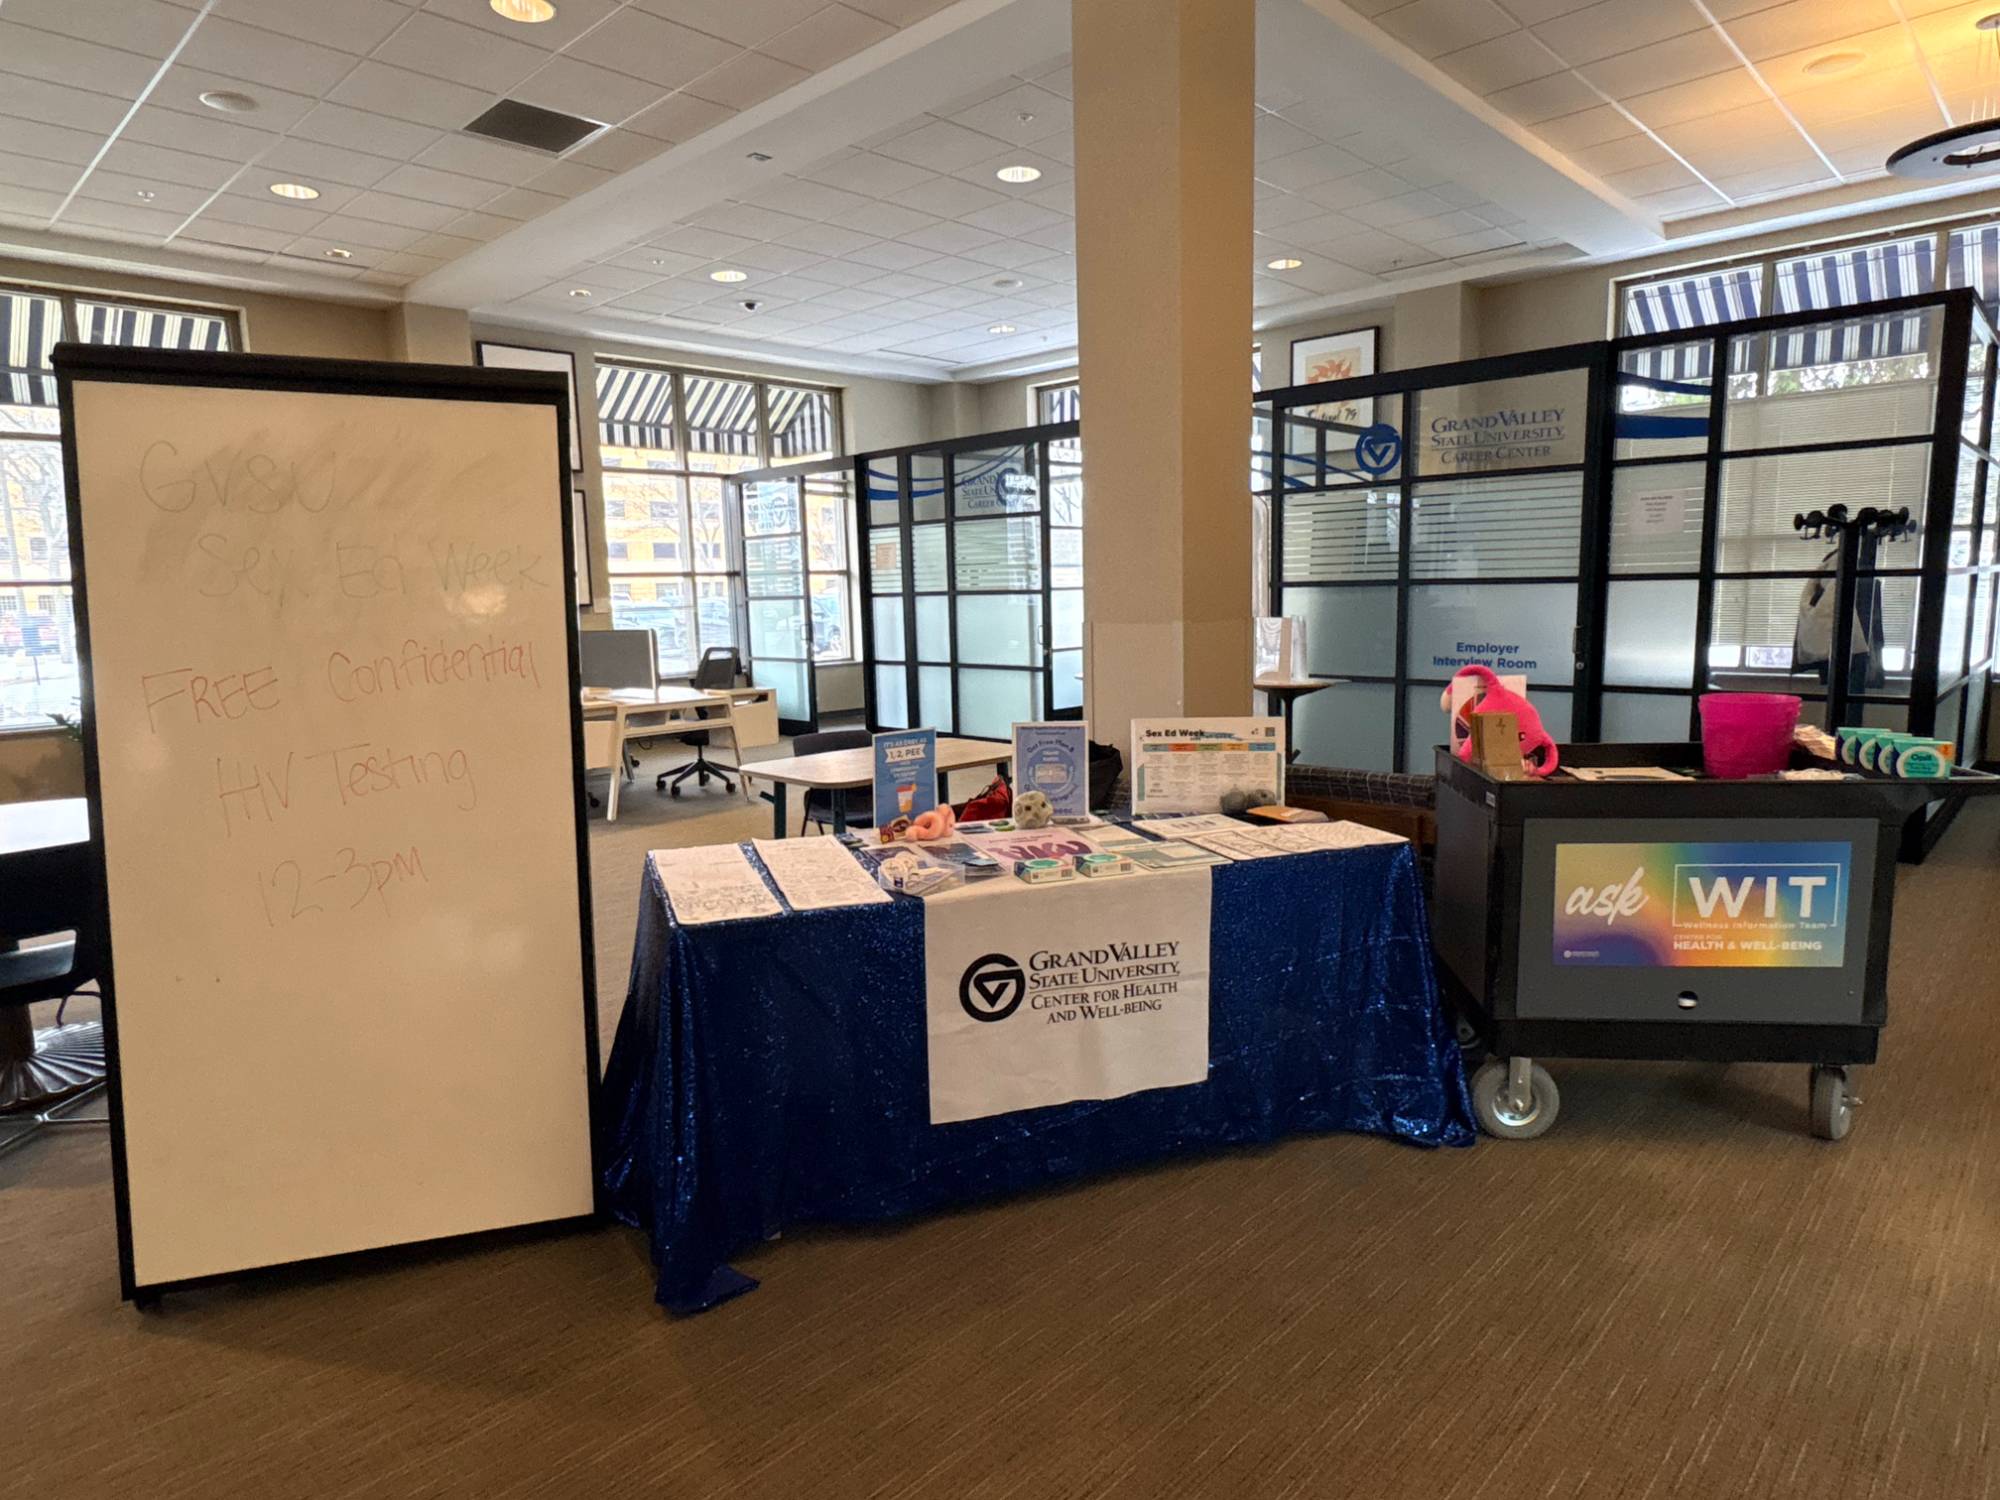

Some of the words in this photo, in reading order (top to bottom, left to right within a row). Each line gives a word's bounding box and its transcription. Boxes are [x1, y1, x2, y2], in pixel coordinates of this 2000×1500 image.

[1431, 416, 1498, 434] GRAND
[1499, 408, 1565, 426] VALLEY
[1431, 434, 1471, 447] STATE
[1441, 449, 1493, 464] CAREER
[1495, 446, 1551, 459] CENTER
[139, 439, 336, 513] GVSU
[336, 533, 406, 598] Ed
[428, 538, 549, 592] Week
[1456, 642, 1519, 654] Employer
[1433, 656, 1493, 668] Interview
[1497, 658, 1537, 669] Room
[141, 666, 280, 734] FREE
[328, 634, 541, 702] Confidential
[1145, 729, 1162, 737] Sex
[1164, 729, 1177, 737] Ed
[1179, 729, 1205, 737] Week
[217, 751, 294, 837] HIV
[305, 743, 477, 811] Testing
[1565, 866, 1650, 926] ask
[1688, 876, 1827, 918] WIT
[1732, 921, 1795, 930] Information
[1800, 922, 1828, 930] Team
[1029, 950, 1109, 972] GRAND
[1109, 941, 1180, 962] VALLEY
[1673, 941, 1724, 950] HEALTH
[1727, 942, 1736, 950] &
[1740, 941, 1823, 950] WELL-BEING
[1029, 968, 1078, 990] STATE
[1031, 994, 1090, 1010] CENTER
[1094, 990, 1120, 1003] FOR
[1123, 981, 1178, 999] HEALTH
[1047, 1010, 1077, 1025] AND
[1079, 999, 1162, 1020] WELL-BEING
